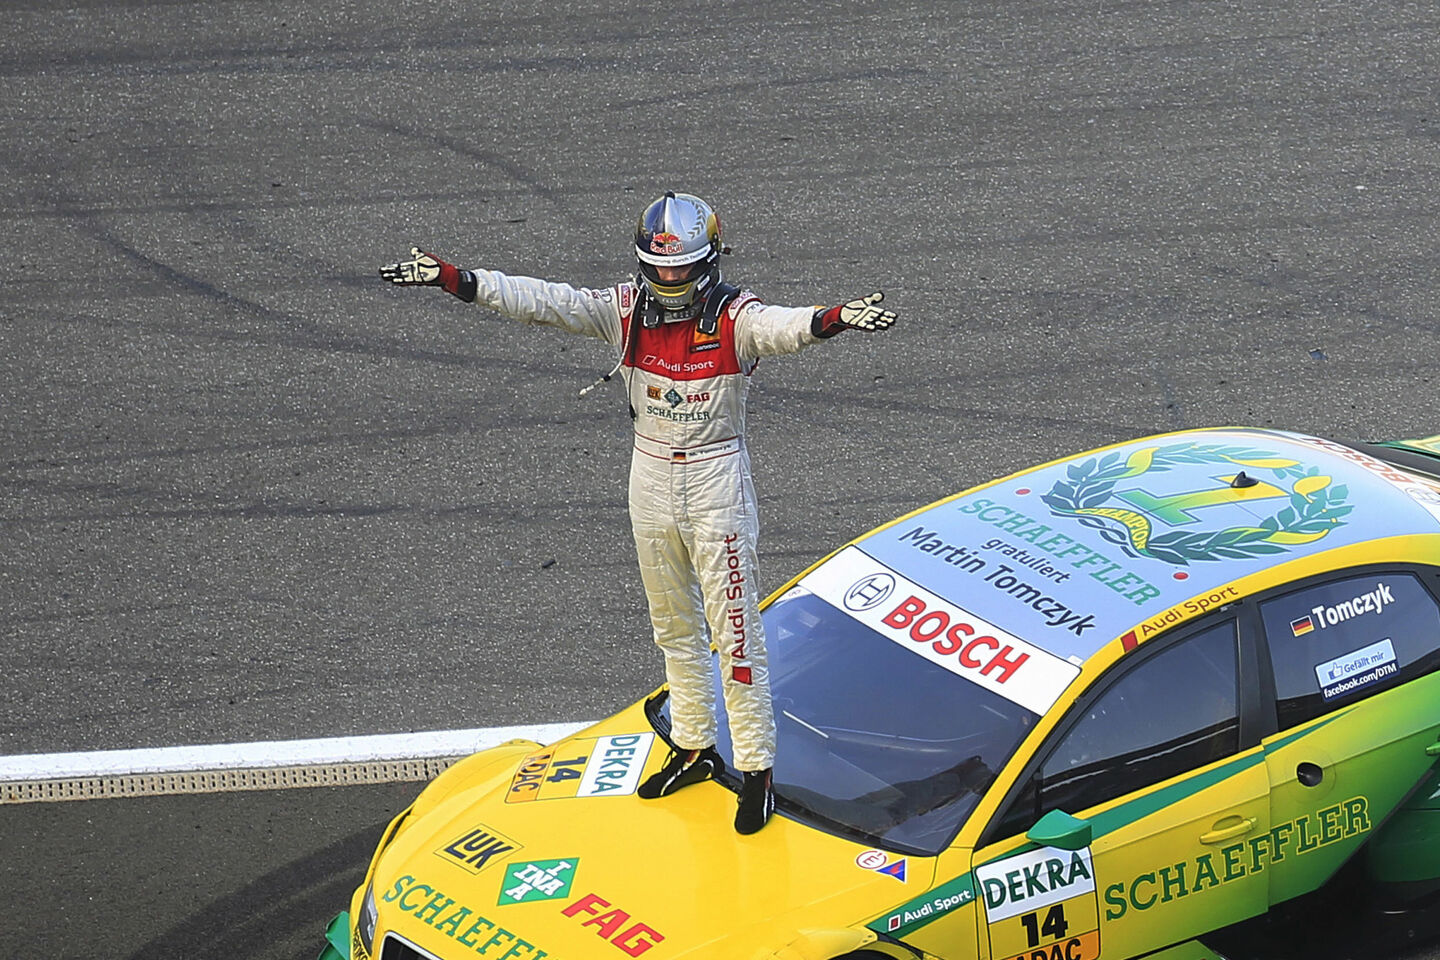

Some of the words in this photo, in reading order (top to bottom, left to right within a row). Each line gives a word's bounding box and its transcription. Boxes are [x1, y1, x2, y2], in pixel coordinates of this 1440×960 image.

[668, 242, 684, 254] Bull
[657, 358, 680, 372] Audi
[684, 360, 714, 372] Sport
[646, 406, 710, 422] SCHAEFFLER
[687, 392, 710, 403] FAG
[1086, 508, 1149, 549] CHAMPION
[724, 532, 744, 600] Sport
[959, 498, 1162, 607] SCHAEFFLER
[980, 536, 1072, 586] gratuliert
[898, 527, 984, 574] Martin
[984, 564, 1096, 638] Tomczyk
[1312, 582, 1395, 628] Tomczyk
[728, 608, 745, 659] Audi
[1140, 610, 1183, 636] Audi
[1184, 585, 1238, 612] Sport
[882, 595, 1030, 684] BOSCH
[1344, 657, 1370, 673] Gefällt
[1371, 652, 1384, 662] mir
[1324, 662, 1397, 698] facebook.com/DTM
[512, 754, 550, 793] ADAC
[546, 754, 588, 783] 14
[590, 736, 640, 795] DEKRA
[983, 851, 1090, 910] DEKRA
[1105, 796, 1371, 921] SCHAEFFLER
[562, 892, 665, 958] FAG
[904, 904, 933, 922] Audi
[934, 890, 971, 910] Sport
[1022, 904, 1068, 948] 14
